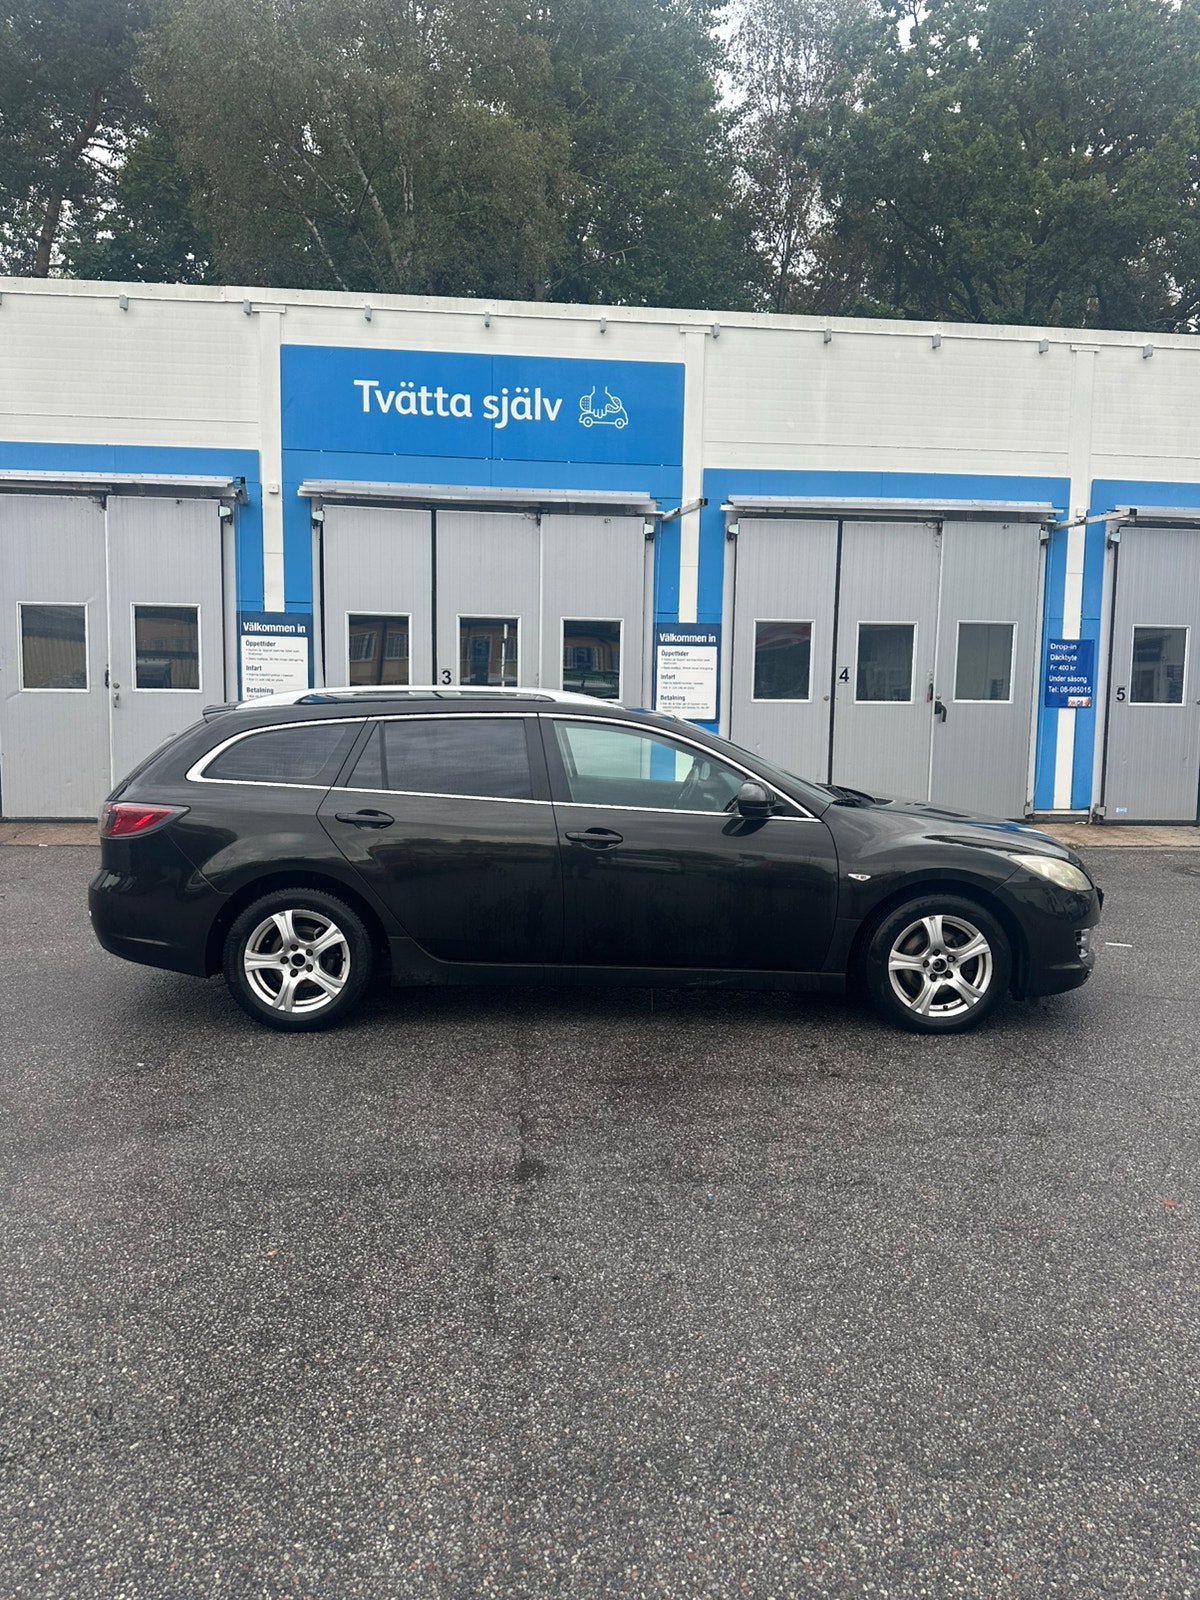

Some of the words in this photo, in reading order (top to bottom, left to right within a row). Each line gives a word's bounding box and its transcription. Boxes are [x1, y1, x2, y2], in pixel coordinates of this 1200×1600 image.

[353, 379, 473, 418] Tvätta
[483, 387, 563, 429] själv
[243, 622, 295, 633] Välkommen
[297, 624, 306, 633] in
[659, 633, 707, 643] Välkommen
[708, 634, 716, 643] in
[1050, 643, 1077, 651] Drop-in
[1050, 654, 1078, 662] Däckbyte
[442, 670, 452, 685] 3
[839, 668, 849, 682] 4
[1116, 687, 1125, 701] 5
